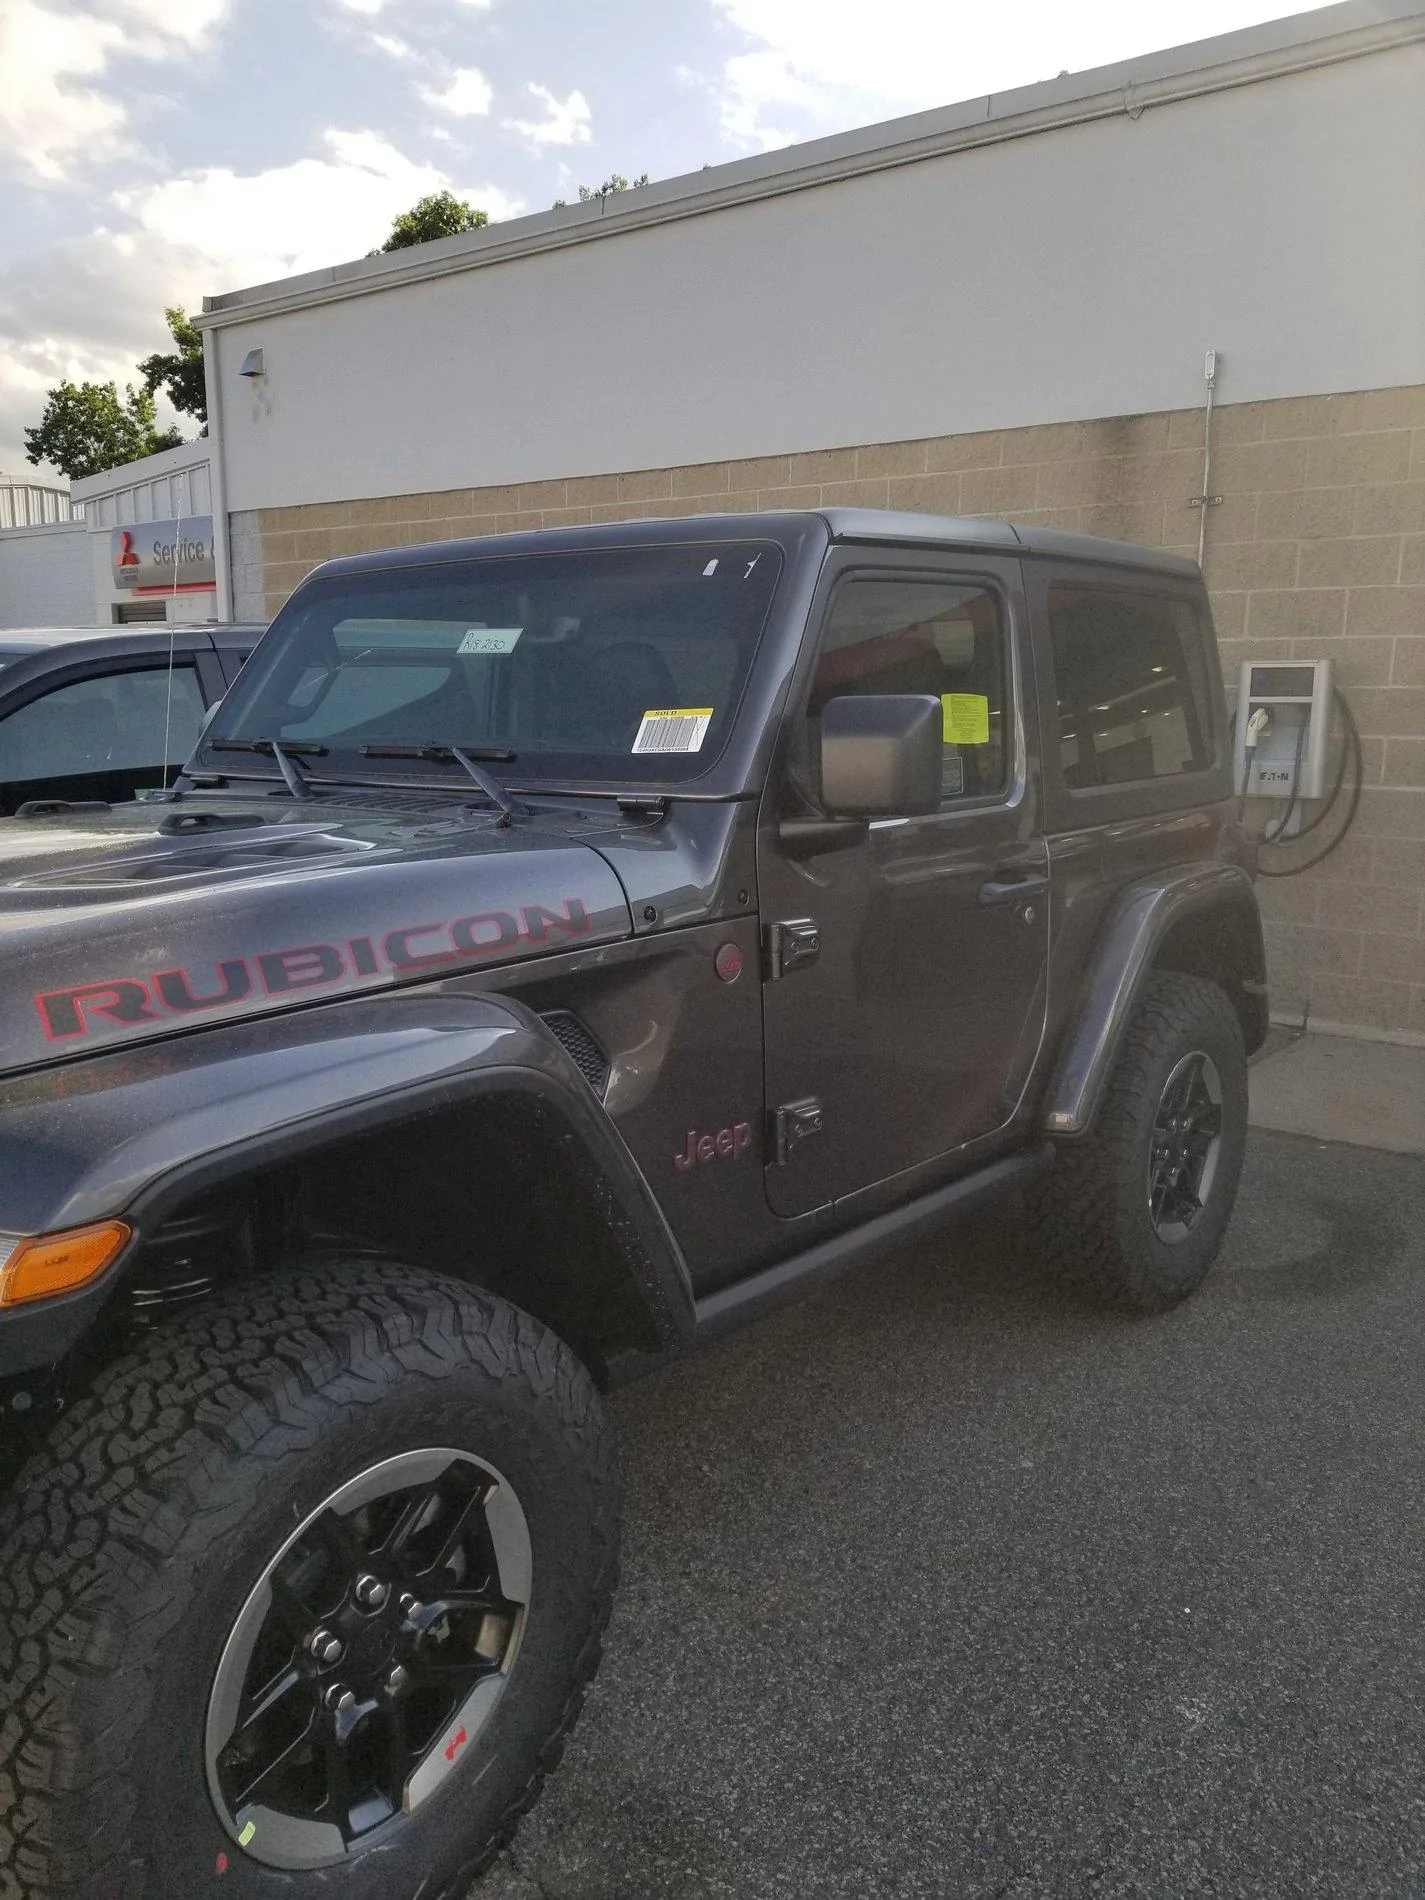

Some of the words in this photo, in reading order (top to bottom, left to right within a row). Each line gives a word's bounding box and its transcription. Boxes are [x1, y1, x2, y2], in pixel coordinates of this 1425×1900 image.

[153, 538, 205, 566] Service
[35, 899, 592, 1042] RUBICON
[673, 1122, 752, 1170] Jeep
